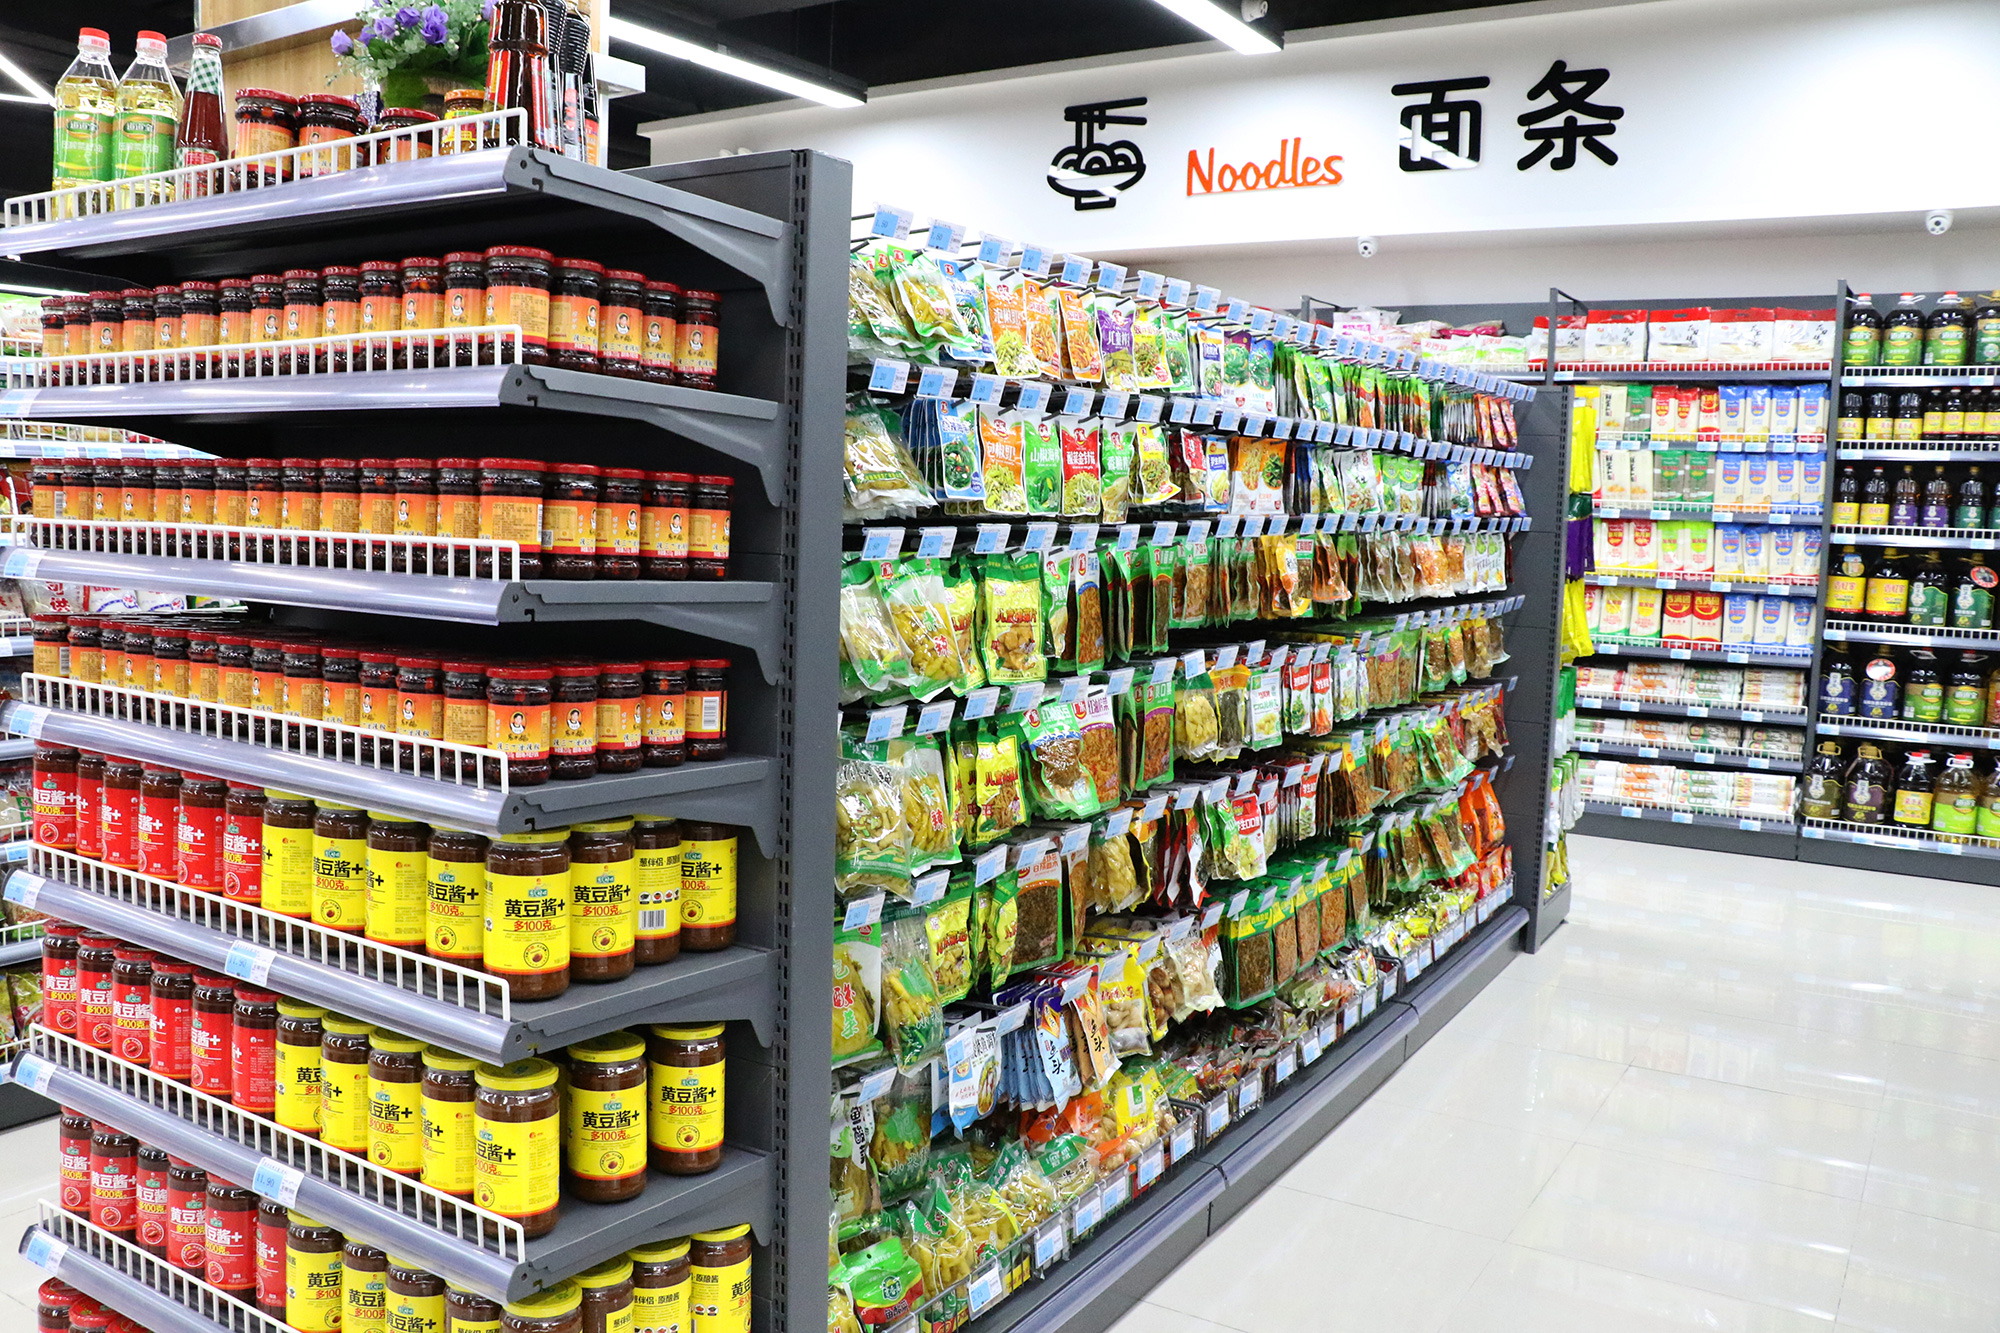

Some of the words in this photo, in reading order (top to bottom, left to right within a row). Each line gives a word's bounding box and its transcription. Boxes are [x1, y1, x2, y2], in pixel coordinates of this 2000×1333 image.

[1391, 60, 1624, 172] 面条
[1187, 137, 1344, 194] Noodles
[573, 884, 631, 904] 黄豆酱+
[504, 898, 566, 918] 黄豆酱+
[661, 1086, 716, 1104] 黄豆酱+
[582, 1110, 640, 1129] 黄豆酱+
